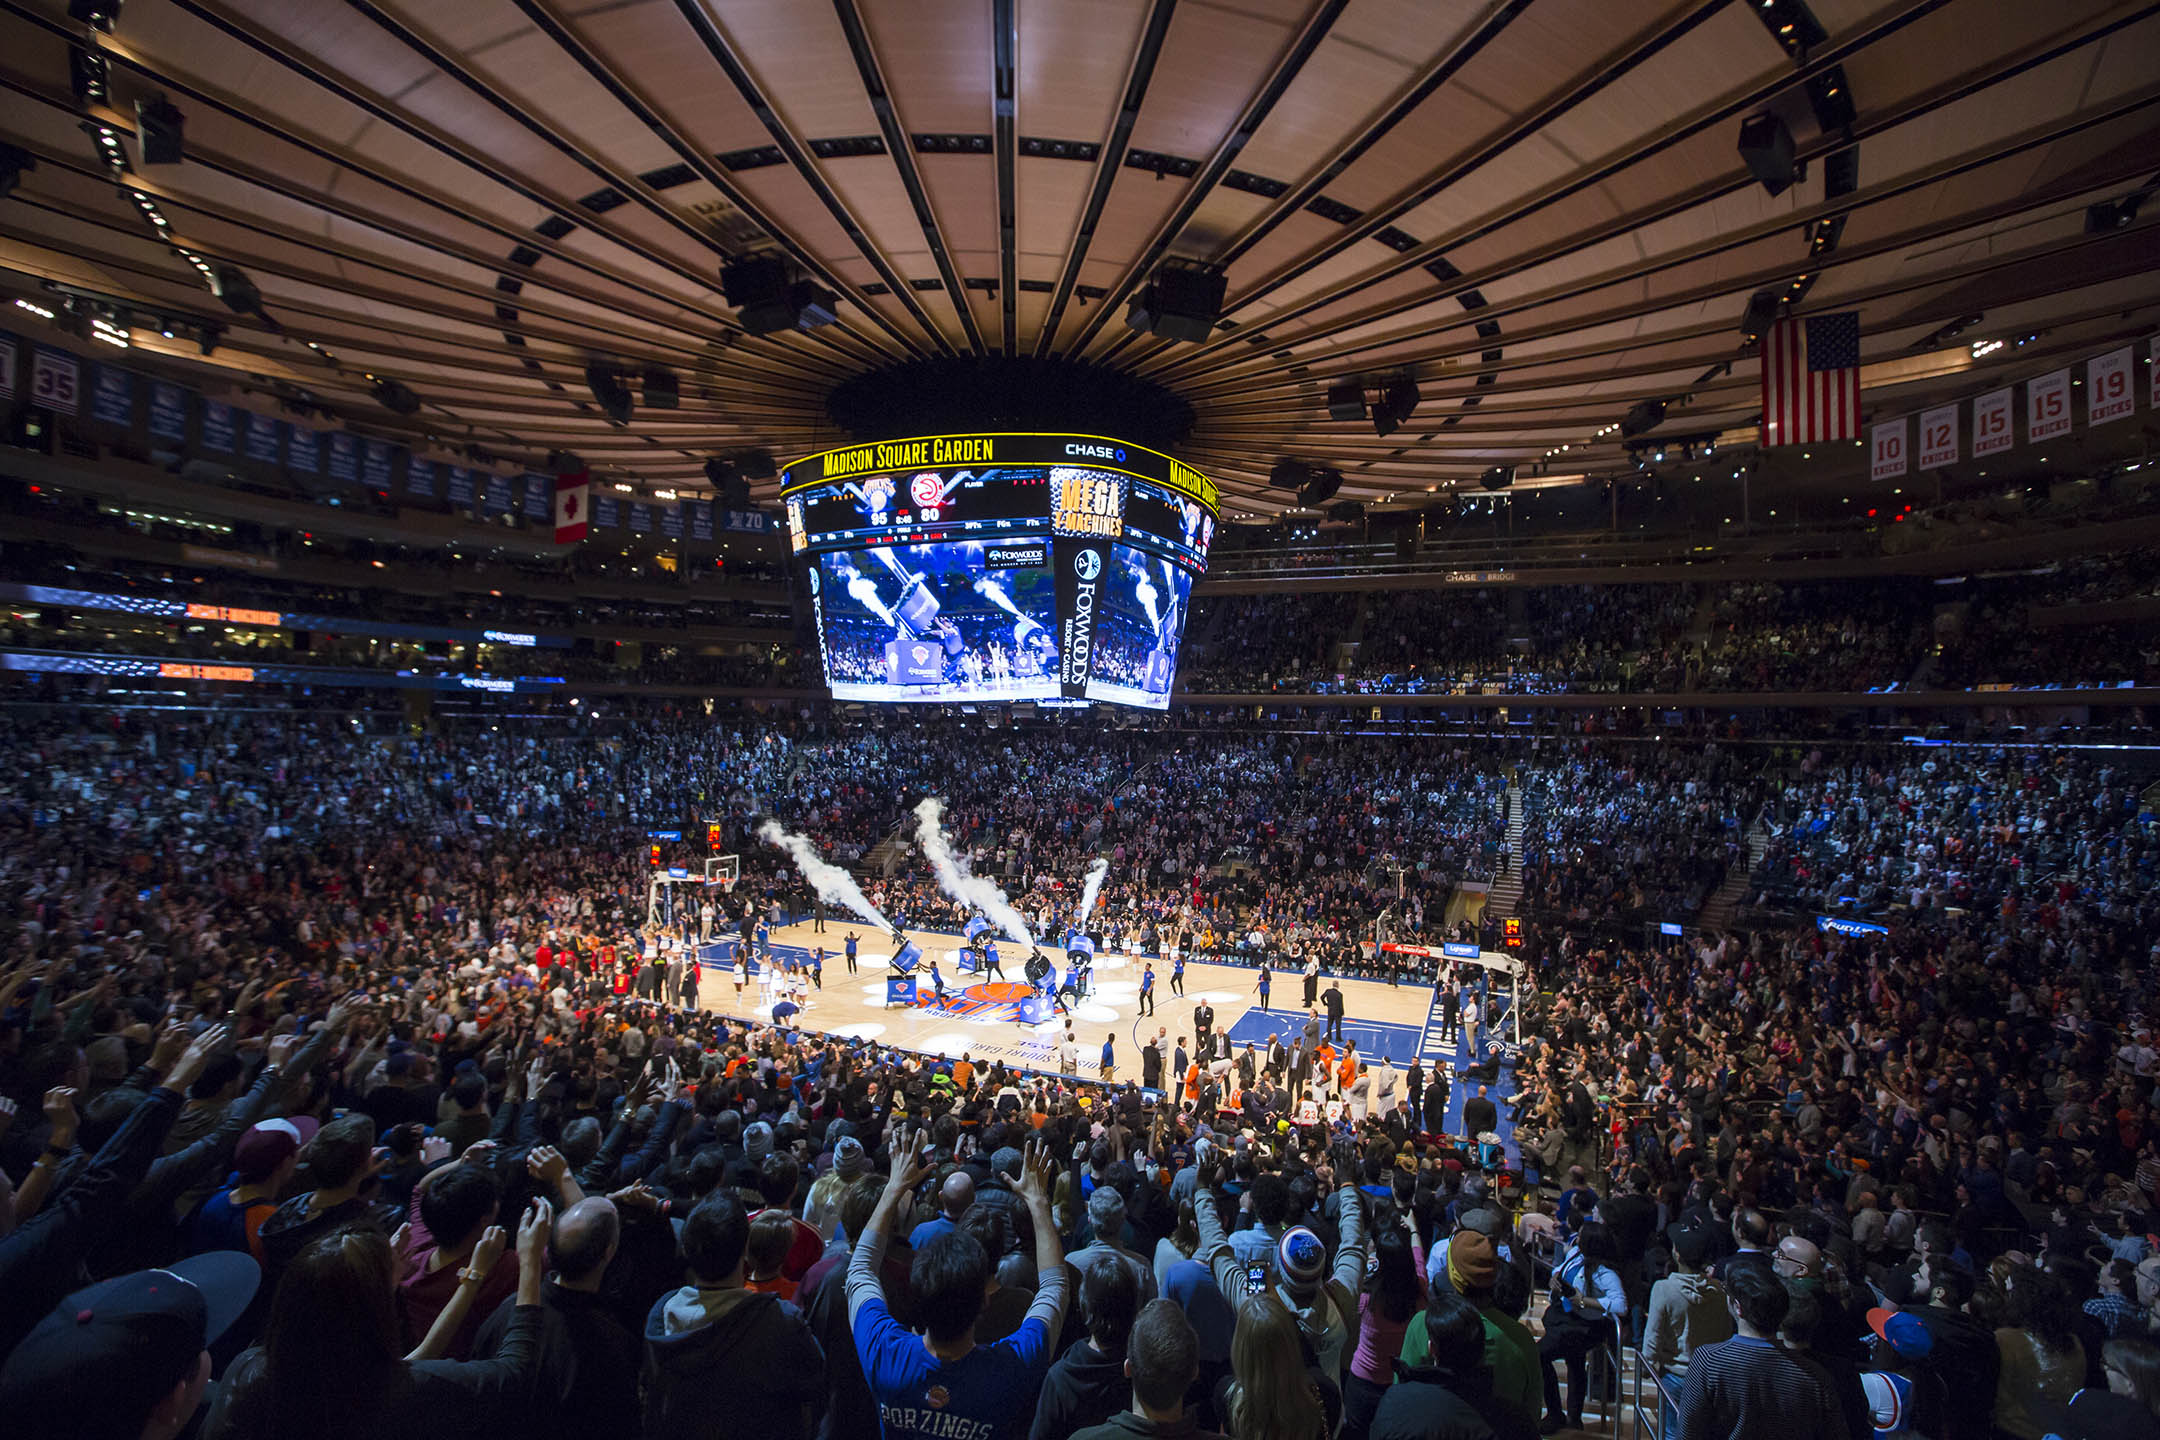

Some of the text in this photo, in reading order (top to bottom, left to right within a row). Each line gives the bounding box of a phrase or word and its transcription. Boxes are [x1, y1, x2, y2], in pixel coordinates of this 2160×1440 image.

[38, 368, 72, 400] 35
[2095, 371, 2124, 403] 19
[2034, 391, 2062, 420] 15
[2091, 399, 2131, 421] KNICKS
[1979, 408, 2005, 436] 15
[2031, 418, 2069, 438] KNICKS
[1926, 423, 1951, 450] 12
[1976, 435, 2010, 452] KNICKS
[823, 439, 993, 477] MADISON SQUARE GARDEN
[1065, 444, 1114, 459] CHASE
[1878, 437, 1900, 462] 10
[1922, 449, 1956, 466] KNICKS
[1170, 460, 1201, 496] MADISON
[1060, 480, 1119, 516] MEGA
[871, 512, 888, 526] 95
[920, 508, 940, 522] 80
[1002, 551, 1043, 560] FOXWOODS
[1445, 573, 1477, 582] CHASE
[1071, 582, 1095, 686] FOXWOODS
[1062, 619, 1073, 683] RESORT CASINO
[1304, 1110, 1317, 1120] 23
[1330, 1109, 1337, 1118] 2
[880, 1401, 993, 1440] PORZINGIS
